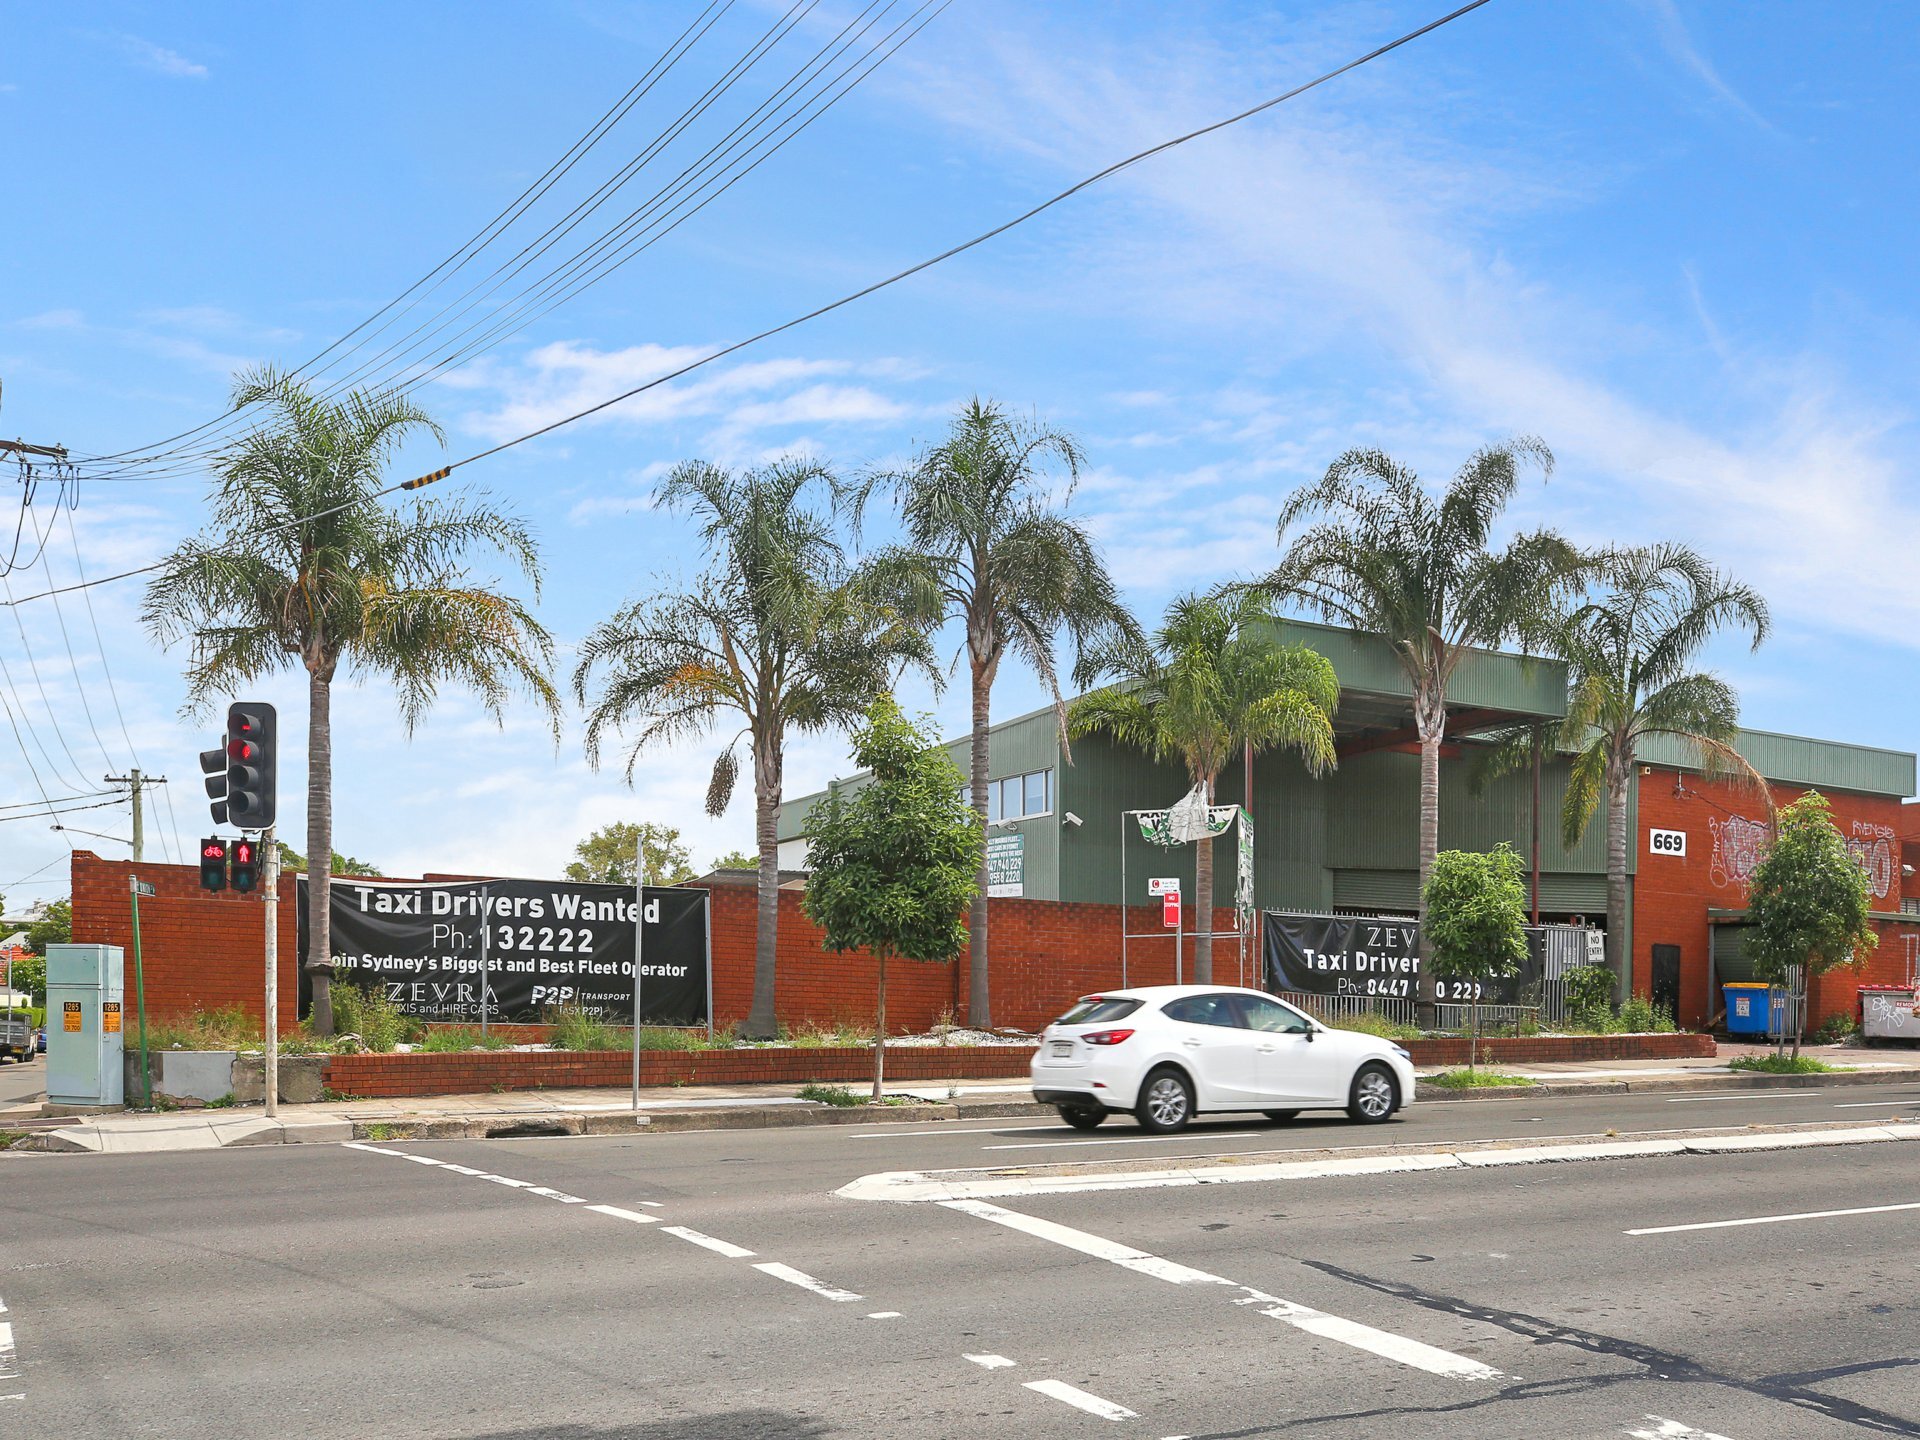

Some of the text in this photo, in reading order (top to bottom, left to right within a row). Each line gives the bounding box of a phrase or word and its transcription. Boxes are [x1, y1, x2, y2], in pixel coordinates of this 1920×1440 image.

[1654, 834, 1682, 851] 669
[1010, 858, 1021, 869] 229
[355, 887, 660, 923] Taxi Drivers Wanted
[433, 924, 593, 953] Ph: 132222
[1367, 927, 1416, 948] ZEV
[1303, 949, 1419, 973] Taxi Driver
[1589, 947, 1602, 955] ENTRY
[331, 953, 357, 968] oin
[362, 954, 437, 973] Sydney's
[442, 956, 502, 973] Biggest
[506, 958, 535, 972] and
[540, 958, 574, 974] Best
[578, 960, 618, 975] Fleet
[386, 983, 498, 1003] ZEVRA
[530, 985, 630, 1005] P2P TRANSPORT
[1338, 978, 1362, 995] Ph:
[1367, 979, 1408, 996] 0447
[1452, 982, 1481, 999] 229
[420, 1004, 438, 1014] and
[442, 1004, 467, 1014] HIRE
[470, 1004, 499, 1014] CARS
